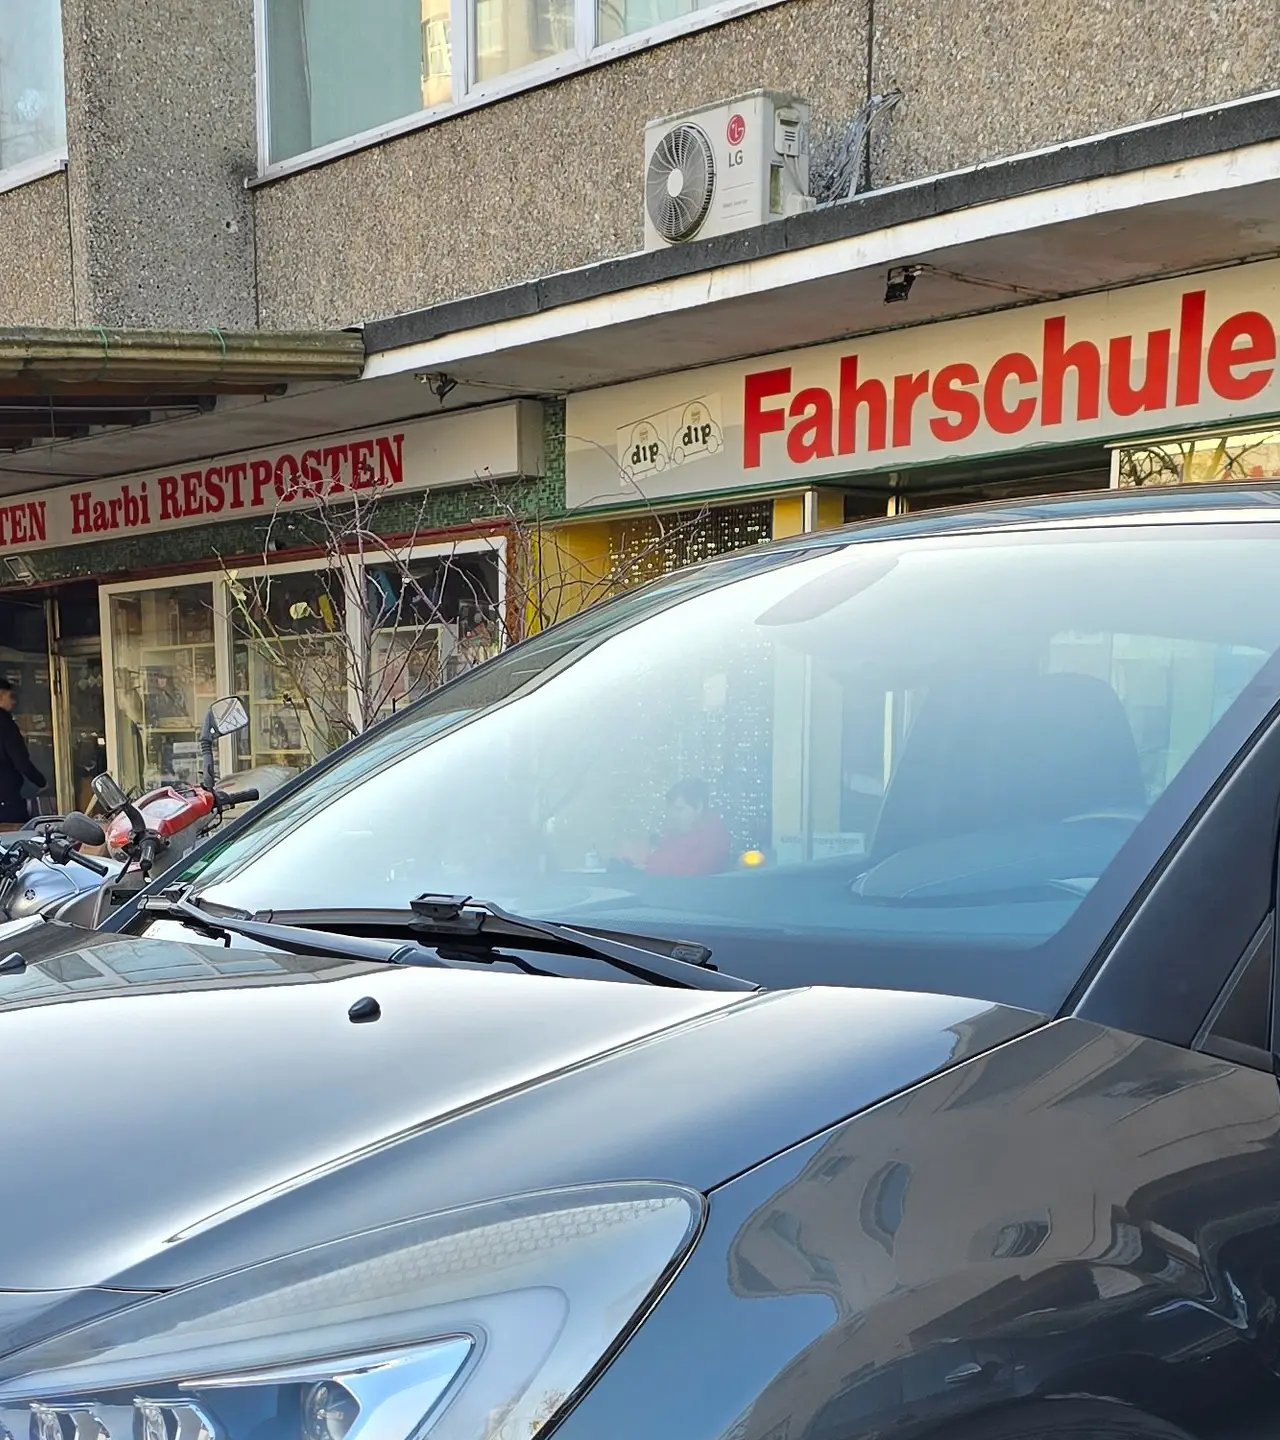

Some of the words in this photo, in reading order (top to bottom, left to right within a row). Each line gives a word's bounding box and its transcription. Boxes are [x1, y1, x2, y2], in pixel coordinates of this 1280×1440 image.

[729, 150, 743, 168] LG
[743, 290, 1277, 470] Fahrschule
[70, 481, 150, 534] Harbi
[158, 434, 405, 520] RESTPOSTEN
